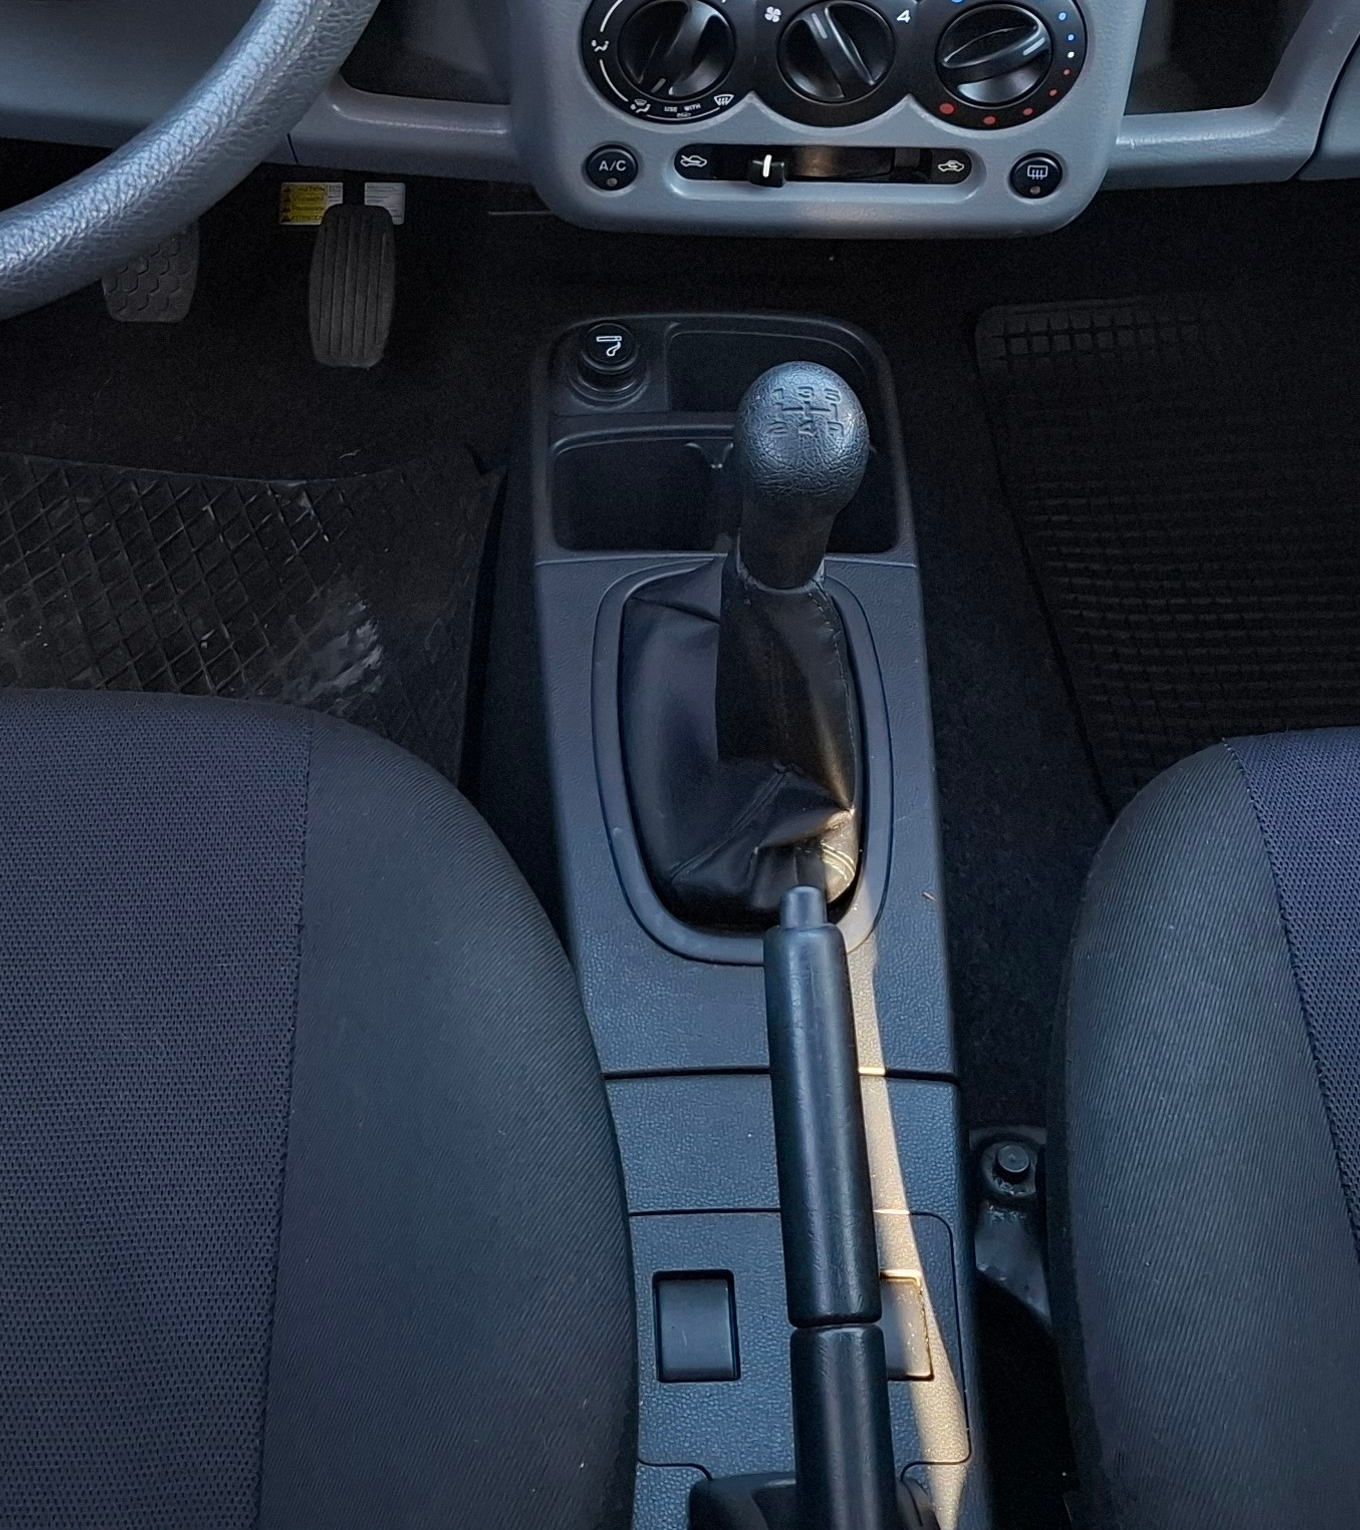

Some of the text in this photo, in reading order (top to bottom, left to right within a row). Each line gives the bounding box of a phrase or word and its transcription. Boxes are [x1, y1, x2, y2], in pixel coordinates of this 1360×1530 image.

[896, 9, 911, 23] 4
[598, 158, 627, 173] A/C
[798, 385, 814, 399] 3
